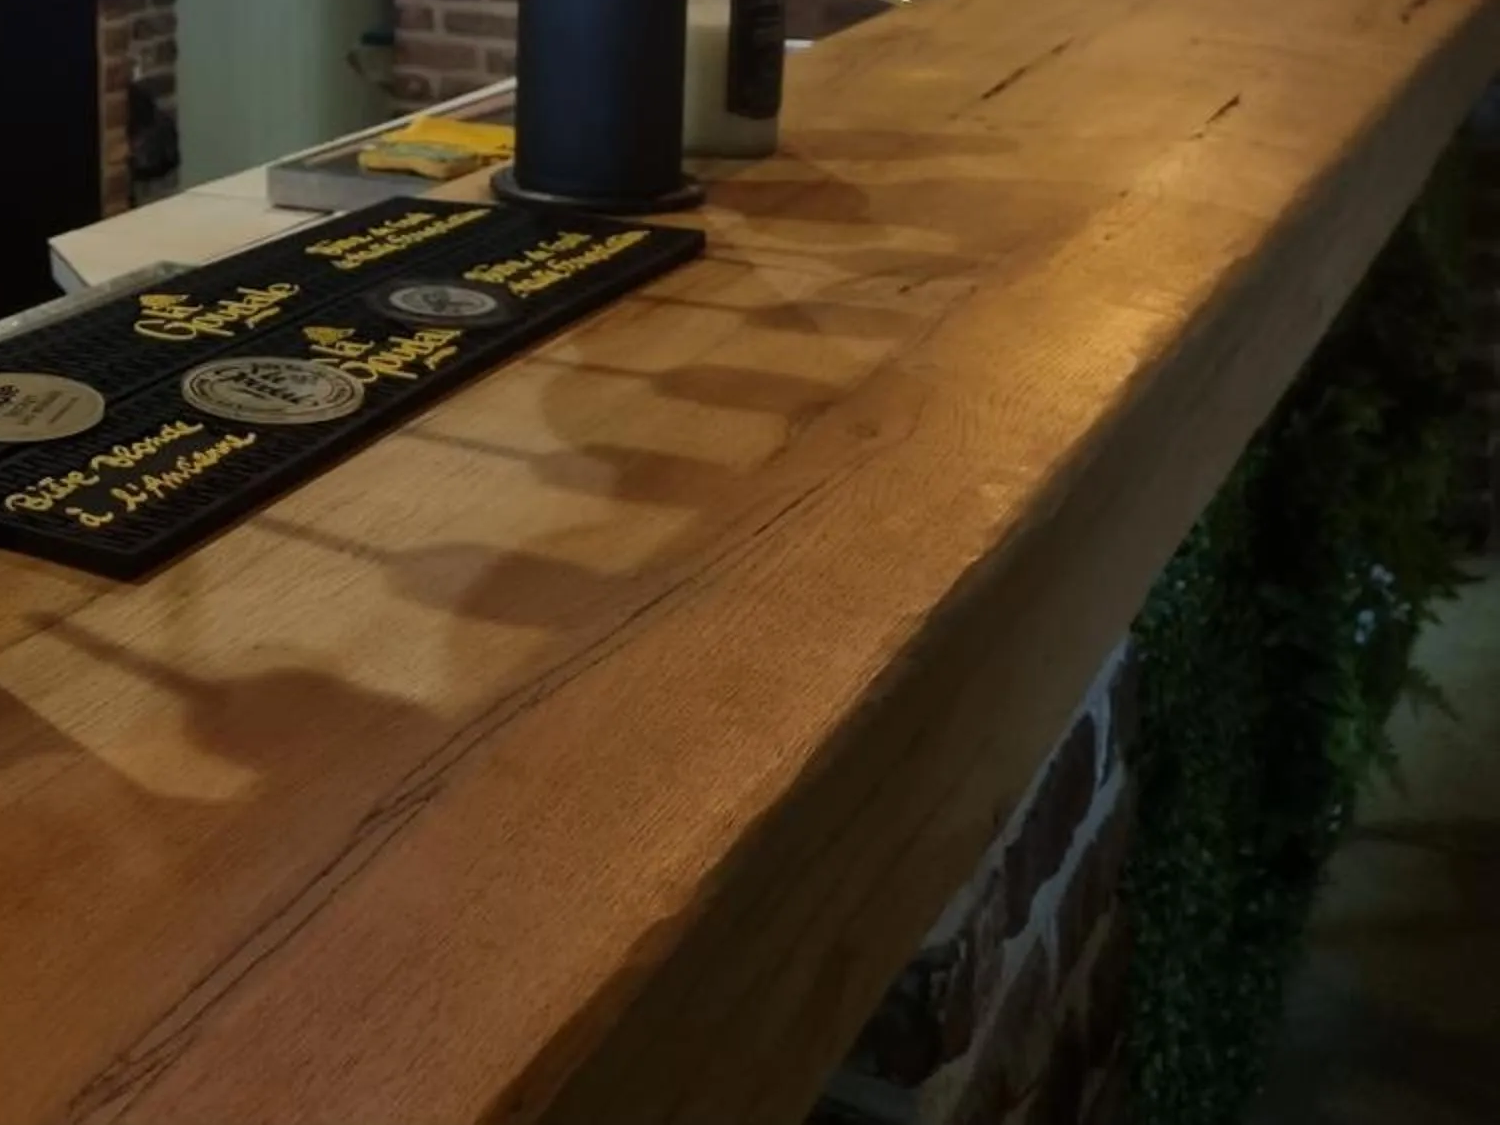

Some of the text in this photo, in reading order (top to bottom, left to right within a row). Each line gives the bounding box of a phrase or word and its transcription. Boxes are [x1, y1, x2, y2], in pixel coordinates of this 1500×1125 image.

[133, 282, 301, 341] Goudale
[4, 420, 204, 512] Bière Blonde
[64, 506, 115, 527] à
